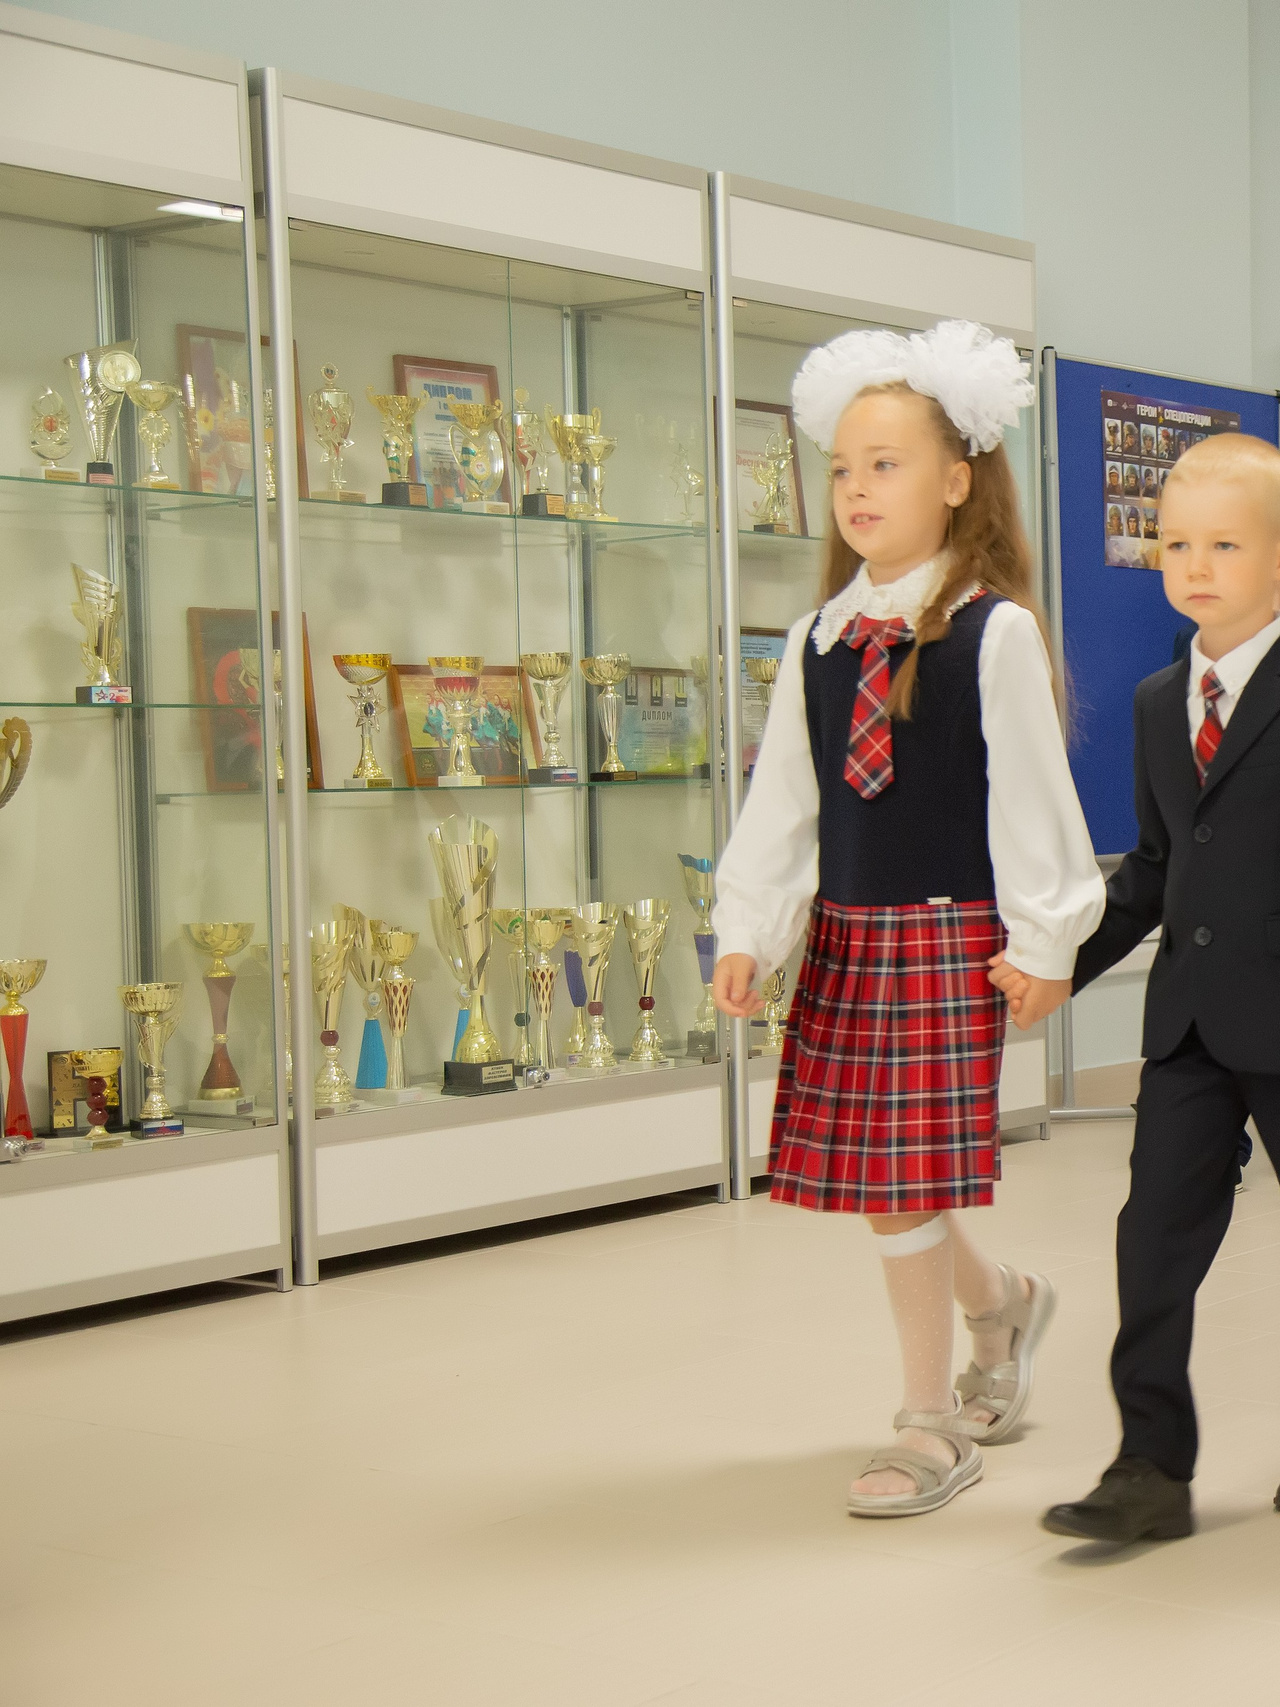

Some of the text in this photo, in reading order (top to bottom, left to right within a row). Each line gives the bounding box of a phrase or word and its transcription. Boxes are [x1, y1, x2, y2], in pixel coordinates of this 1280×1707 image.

[1136, 404, 1212, 427] ГЕРОИ СПЕЦОПЕРАЦИИ
[641, 710, 673, 722] ДИПЛОМ
